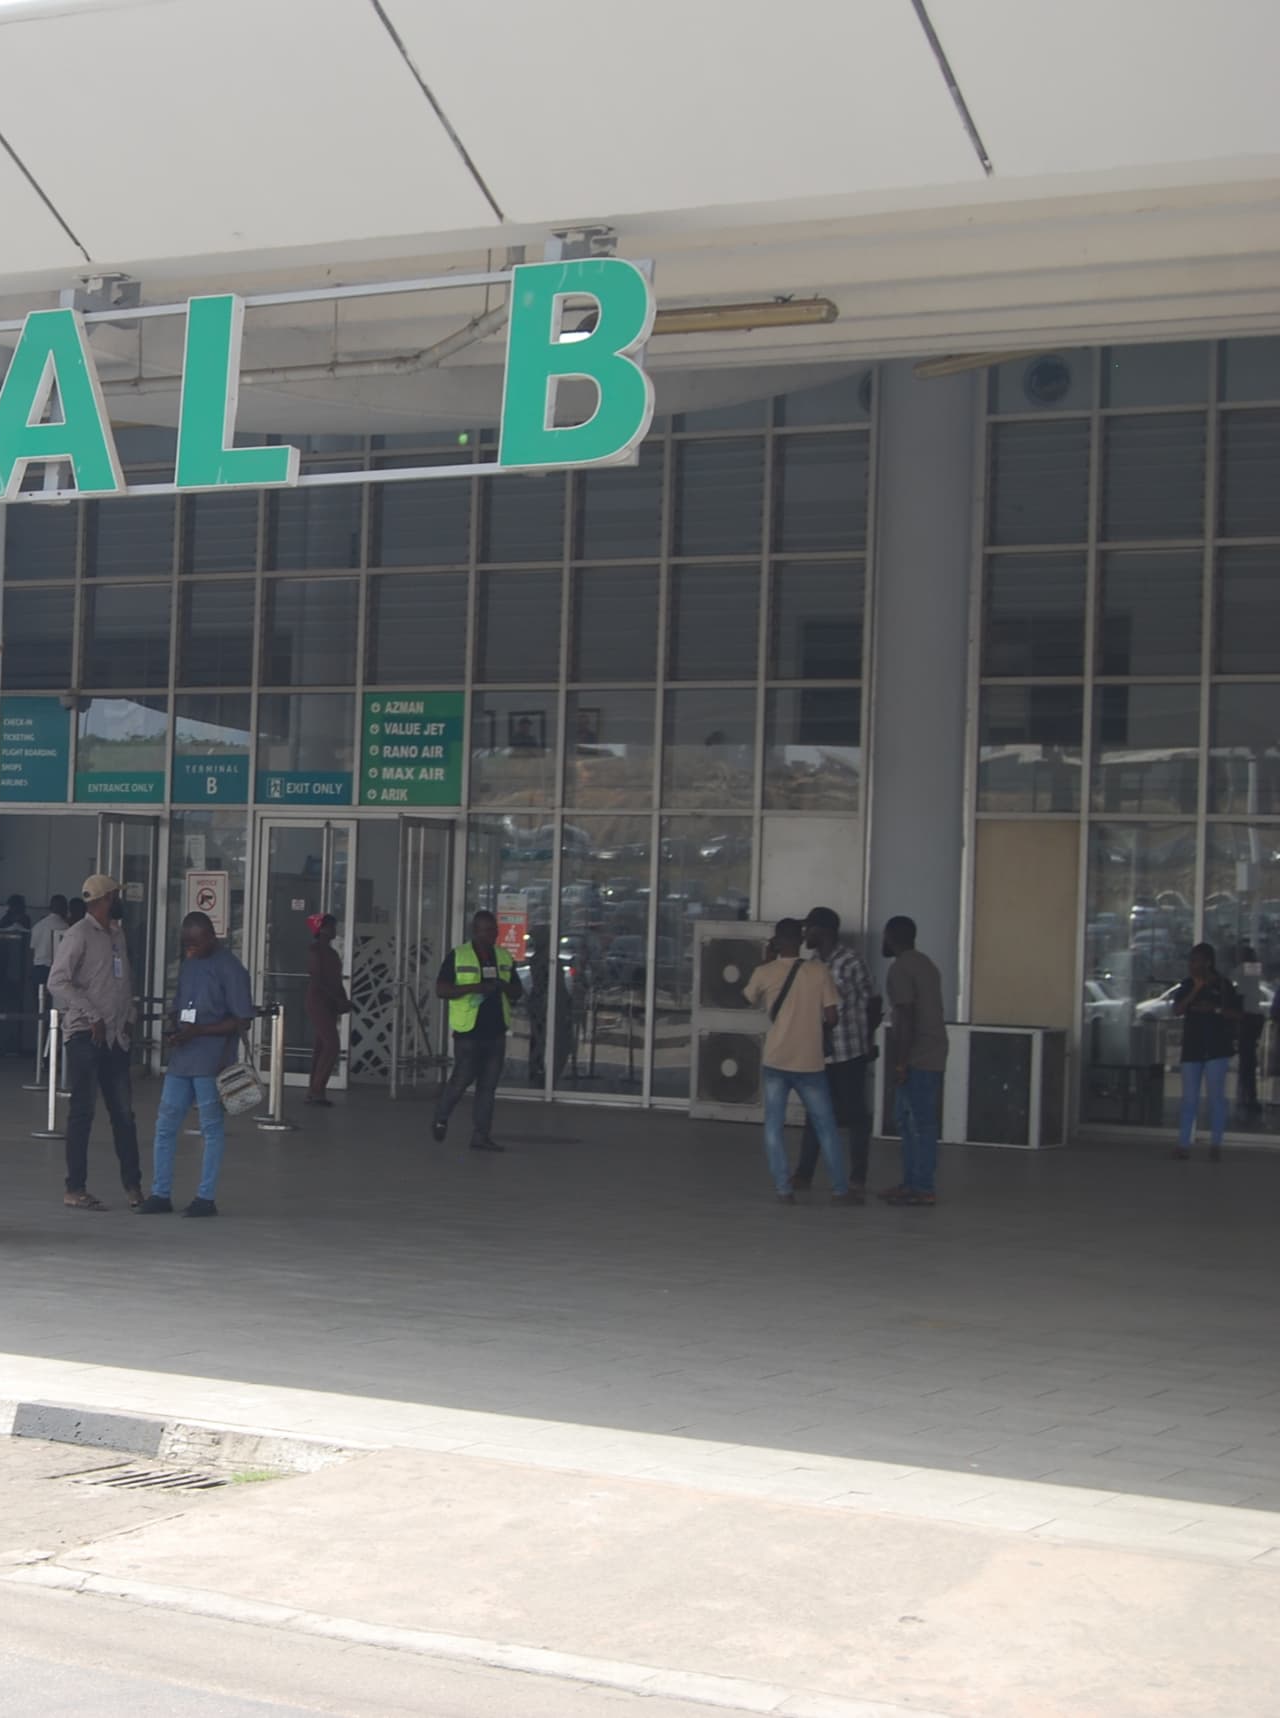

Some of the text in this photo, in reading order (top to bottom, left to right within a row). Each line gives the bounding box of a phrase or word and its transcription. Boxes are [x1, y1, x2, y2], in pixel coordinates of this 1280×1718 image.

[498, 257, 657, 471] B
[384, 701, 424, 714] AZMAN
[384, 722, 446, 735] VALUE JET
[2, 733, 35, 741] TICKETING
[383, 745, 444, 758] RANO AIR
[185, 764, 239, 773] TERMINAL
[382, 767, 445, 780] MAX AIR
[87, 783, 155, 793] ENTRANCE ONLY
[206, 776, 218, 795] B
[286, 782, 343, 794] EXIT ONLY
[380, 788, 408, 801] ARIK
